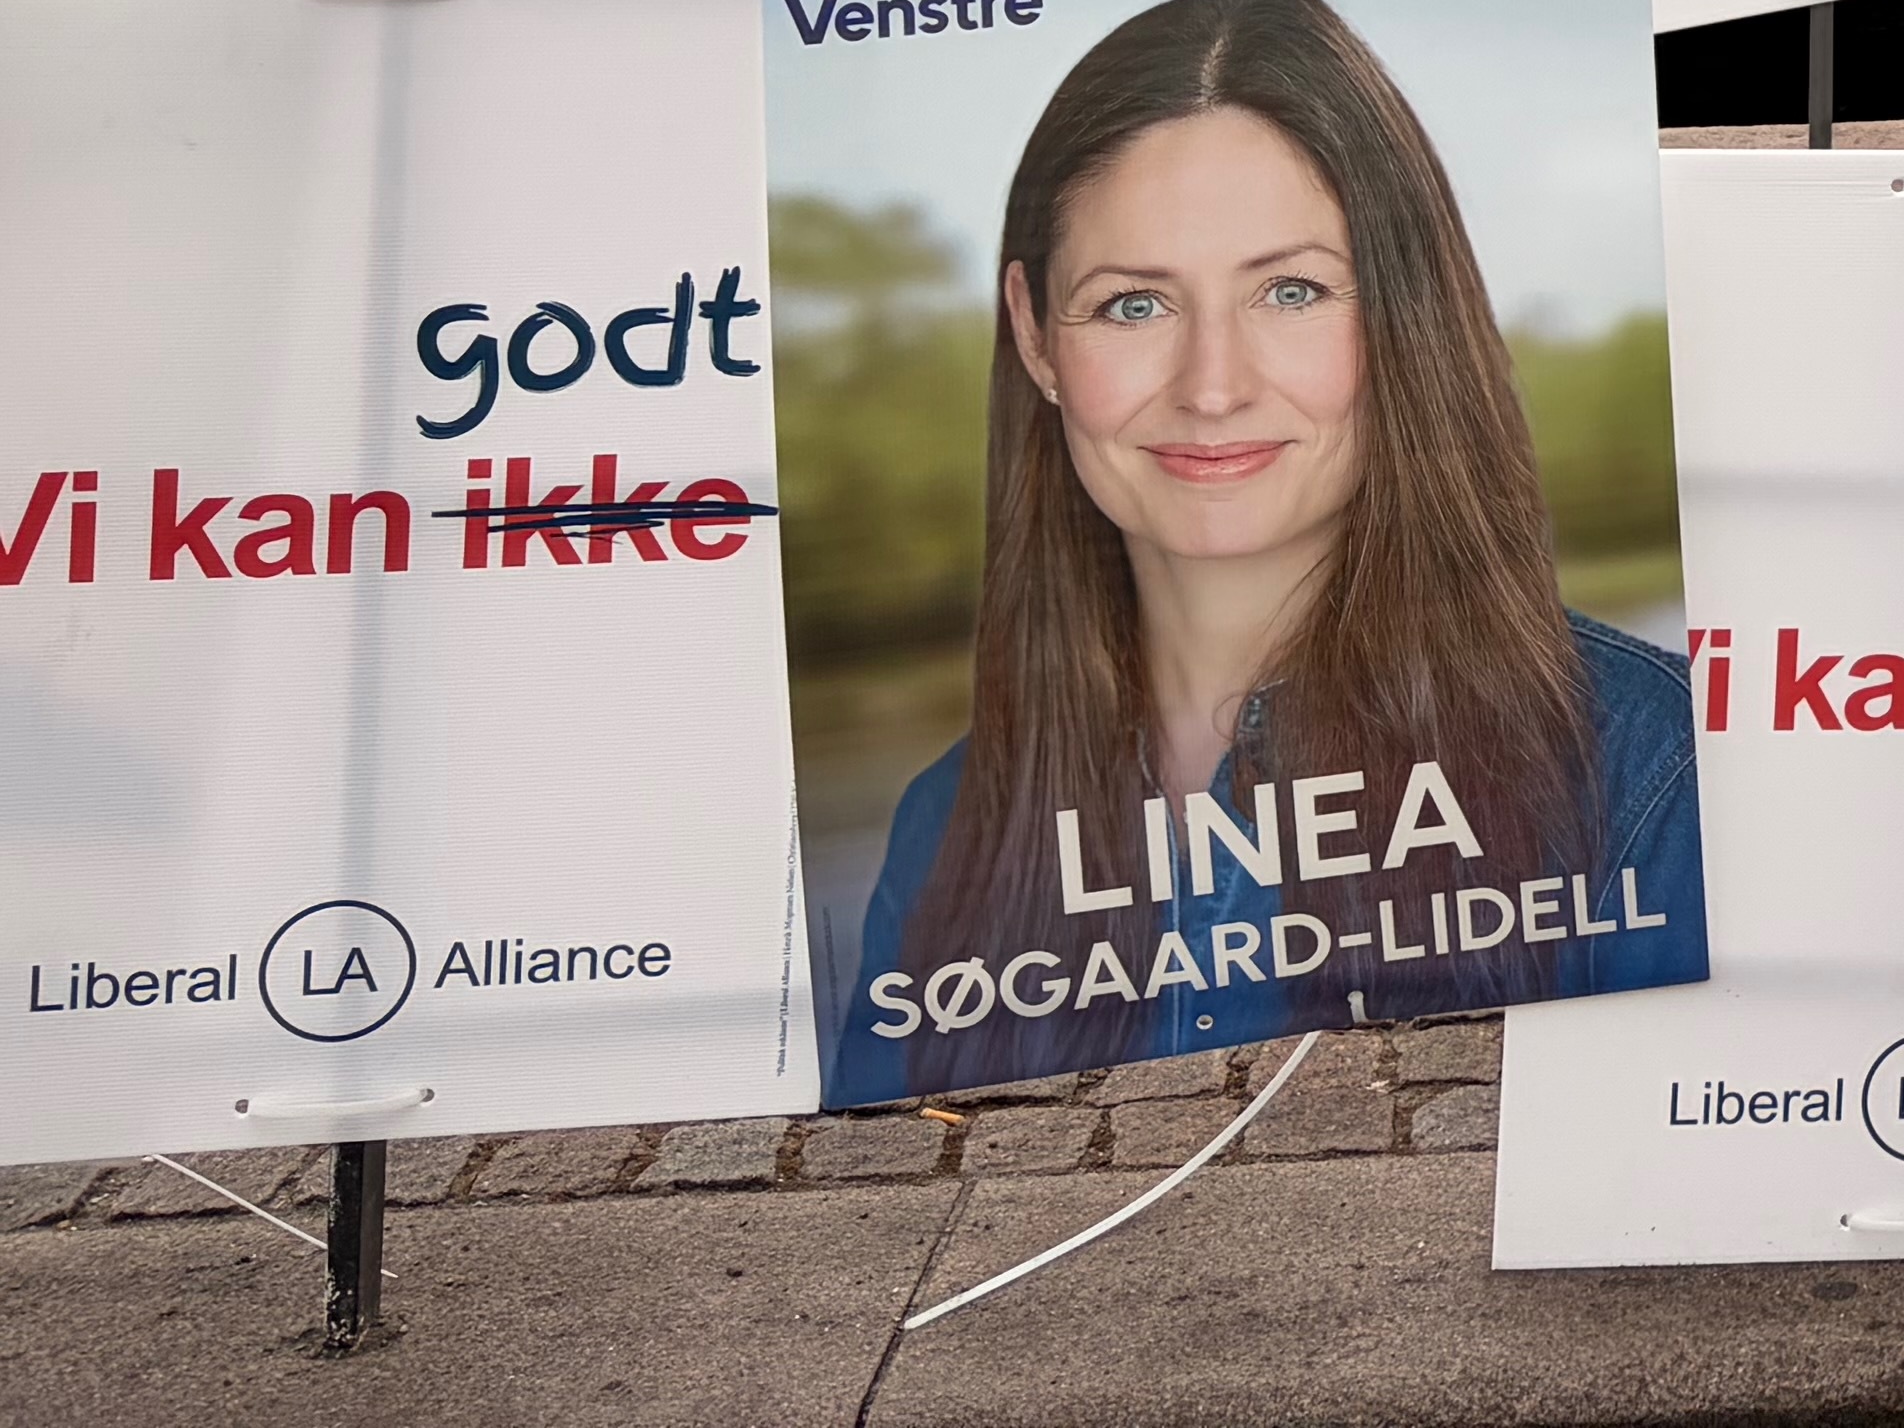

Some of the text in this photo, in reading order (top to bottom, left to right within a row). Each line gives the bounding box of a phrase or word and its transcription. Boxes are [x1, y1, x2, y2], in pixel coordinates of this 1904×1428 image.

[416, 266, 761, 439] godt
[0, 455, 751, 587] Vi kan ikke
[1688, 629, 1732, 732] i
[1056, 762, 1482, 916] LINEA
[30, 939, 671, 1012] Liberal LA Alliance
[870, 867, 1666, 1037] SØGAARD-LIDELL
[1670, 1078, 1843, 1125] Liberal
